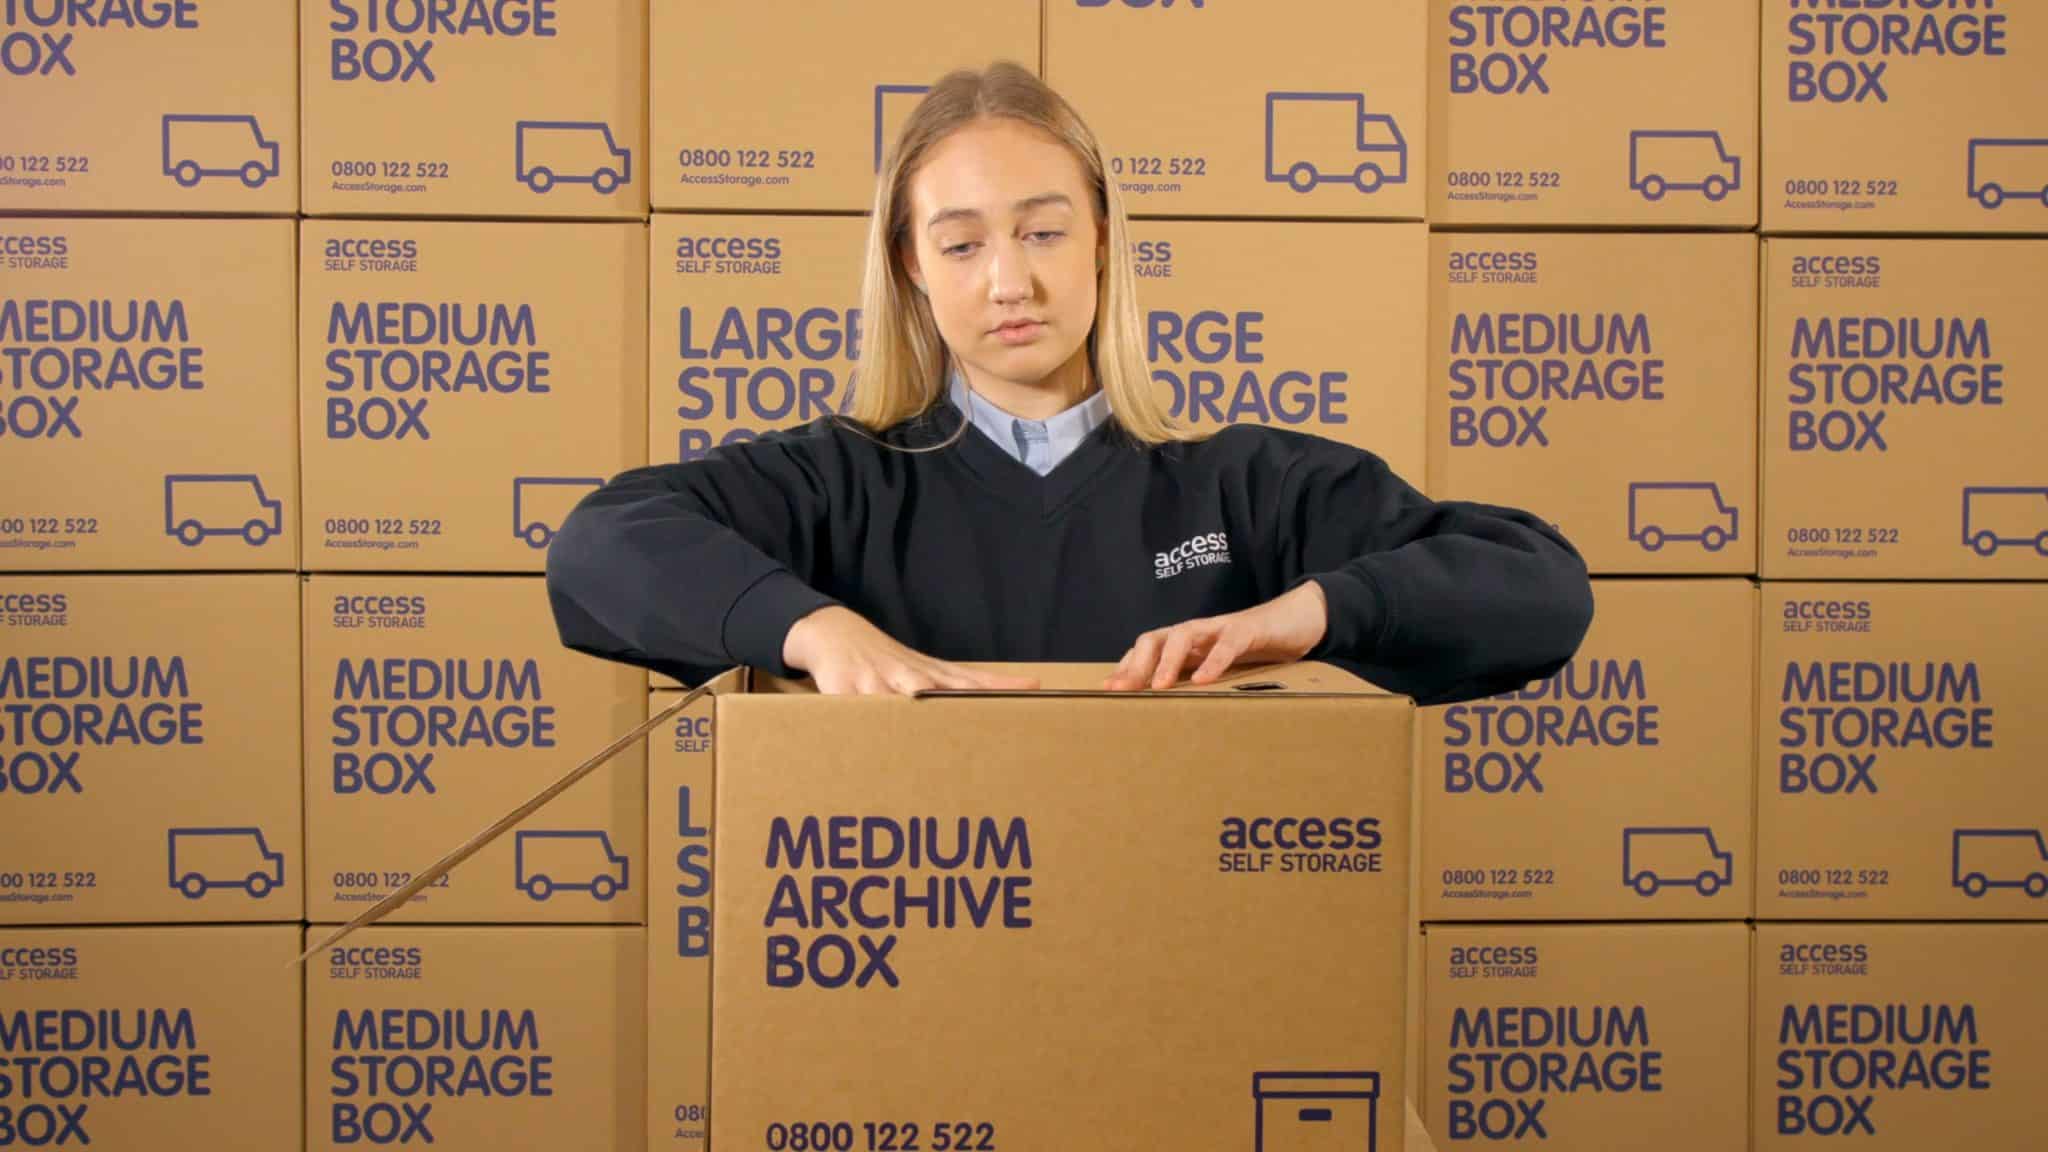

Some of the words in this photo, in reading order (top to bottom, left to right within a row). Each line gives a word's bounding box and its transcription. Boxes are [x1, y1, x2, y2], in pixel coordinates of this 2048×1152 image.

[6, 0, 198, 29] ORAGE
[330, 0, 556, 36] STORAGE
[1449, 5, 1666, 48] STORAGE
[1788, 13, 2006, 56] STORAGE
[332, 39, 435, 83] BOX
[1451, 52, 1549, 94] BOX
[1789, 61, 1888, 102] BOX
[20, 156, 49, 172] 122
[56, 157, 88, 172] 522
[332, 161, 376, 176] 0800
[382, 162, 410, 178] 122
[416, 162, 448, 178] 522
[680, 149, 730, 167] 0800
[737, 150, 770, 167] 122
[777, 151, 814, 168] 522
[1129, 158, 1162, 175] 122
[1169, 158, 1205, 175] 522
[680, 174, 789, 187] AccessStorage.com
[1119, 182, 1181, 193] orage.com
[1448, 172, 1490, 186] 0800
[1496, 172, 1523, 187] 122
[1529, 172, 1560, 187] 522
[1786, 180, 1828, 195] 0800
[1833, 180, 1860, 195] 122
[1866, 180, 1897, 195] 522
[8, 256, 68, 269] STORAGE
[325, 239, 417, 258] access
[677, 238, 781, 259] access
[1449, 252, 1536, 270] access
[325, 259, 355, 271] SELF
[360, 259, 416, 272] STORAGE
[676, 260, 711, 273] SELF
[715, 261, 781, 274] STORAGE
[1448, 272, 1478, 283] SELF
[1482, 272, 1537, 283] STORAGE
[1792, 256, 1880, 274] access
[1792, 276, 1821, 287] SELF
[1825, 276, 1880, 288] STORAGE
[328, 302, 535, 346] MEDIUM
[1451, 313, 1651, 354] MEDIUM
[1791, 318, 1990, 359] MEDIUM
[0, 347, 204, 390] TORAGE
[326, 349, 550, 393] STORAGE
[1449, 359, 1664, 401] STORAGE
[678, 366, 858, 420] STOR
[1789, 363, 2003, 405] STORAGE
[327, 397, 429, 440] BOX
[1450, 406, 1548, 447] BOX
[1789, 410, 1887, 451] BOX
[30, 518, 58, 534] 122
[65, 518, 98, 533] 522
[325, 519, 369, 534] 0800
[375, 519, 403, 534] 122
[409, 520, 440, 535] 522
[1788, 528, 1830, 543] 0800
[1835, 528, 1862, 543] 122
[1868, 528, 1898, 543] 522
[1154, 532, 1228, 568] access
[1155, 561, 1184, 579] SELF
[1185, 551, 1232, 570] STORAGE
[8, 614, 67, 626] STORAGE
[334, 596, 425, 615] access
[1784, 601, 1870, 619] access
[333, 616, 364, 628] SELF
[368, 616, 424, 628] STORAGE
[1784, 620, 1812, 632] SELF
[1816, 620, 1871, 632] STORAGE
[334, 658, 541, 701] MEDIUM
[1782, 662, 1980, 703] MEDIUM
[0, 703, 203, 746] TORAGE
[332, 705, 555, 748] STORAGE
[1444, 705, 1659, 746] STORAGE
[1780, 707, 1992, 748] STORAGE
[675, 739, 711, 753] SELF
[334, 752, 436, 794] BOX
[1445, 752, 1543, 793] BOX
[1780, 753, 1877, 794] BOX
[766, 816, 1032, 869] MEDIUM
[1220, 817, 1381, 850] access
[1219, 853, 1273, 872] SELF
[1280, 853, 1382, 872] STORAGE
[1443, 870, 1485, 885] 0800
[1490, 869, 1517, 884] 122
[1523, 869, 1554, 884] 522
[1779, 870, 1821, 885] 0800
[1826, 870, 1852, 885] 122
[1858, 870, 1888, 885] 522
[28, 872, 56, 888] 122
[64, 872, 96, 887] 522
[333, 872, 378, 887] 0800
[764, 874, 1032, 929] ARCHIVE
[1, 948, 77, 967] ccess
[330, 948, 421, 966] access
[767, 934, 899, 988] BOX
[1450, 947, 1538, 965] access
[1780, 944, 1867, 962] access
[19, 968, 77, 980] STORAGE
[330, 968, 360, 979] SELF
[365, 967, 421, 979] STORAGE
[1450, 966, 1478, 978] SELF
[1483, 966, 1537, 978] STORAGE
[1780, 961, 1809, 975] SELF
[1812, 961, 1867, 976] STORAGE
[0, 1008, 196, 1052] MEDIUM
[333, 1009, 538, 1051] MEDIUM
[1450, 1006, 1648, 1048] MEDIUM
[1779, 1004, 1978, 1044] MEDIUM
[331, 1055, 552, 1097] STORAGE
[1448, 1051, 1662, 1094] STORAGE
[1777, 1049, 1990, 1090] STORAGE
[333, 1102, 434, 1144] BOX
[1449, 1099, 1547, 1140] BOX
[1778, 1095, 1875, 1136] BOX
[766, 1122, 853, 1152] 0800
[864, 1122, 919, 1151] 122
[932, 1122, 994, 1151] 522
